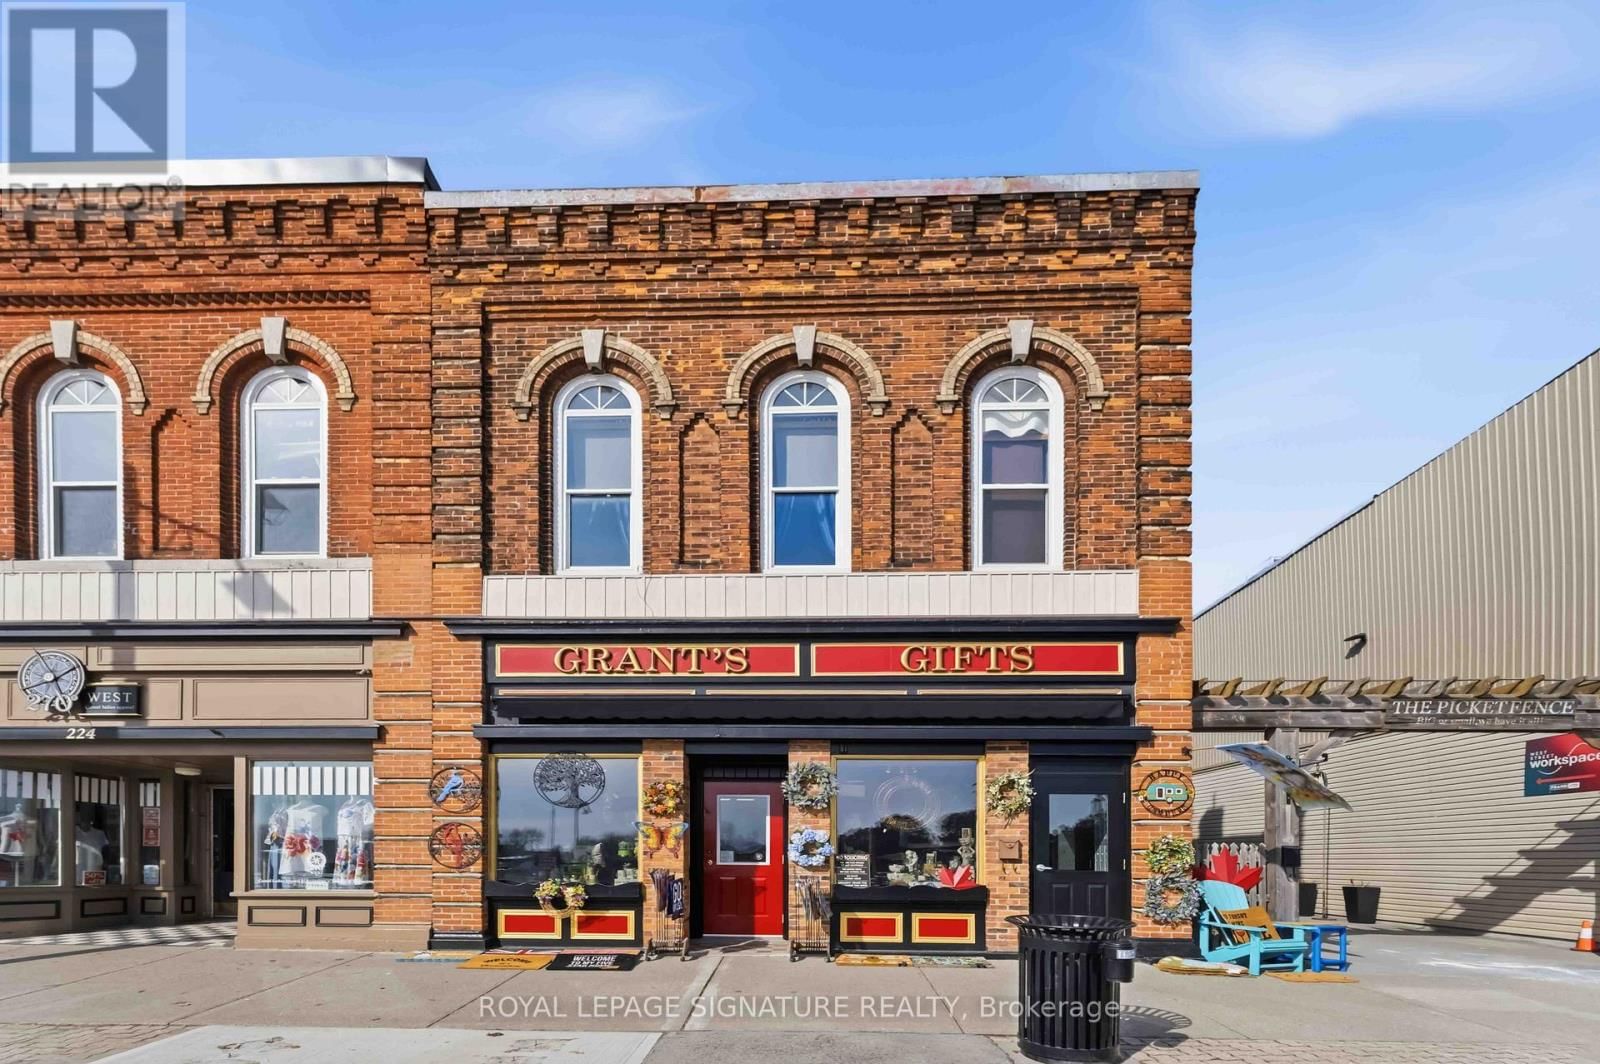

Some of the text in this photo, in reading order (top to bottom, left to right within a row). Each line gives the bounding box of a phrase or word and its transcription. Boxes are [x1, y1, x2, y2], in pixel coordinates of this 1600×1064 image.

[553, 646, 750, 674] GRANT'S
[900, 645, 1035, 673] GIFTS
[88, 692, 133, 703] WEST
[1392, 700, 1577, 715] THE PICKET FENCE
[65, 728, 97, 740] 224
[1529, 752, 1600, 769] workspace
